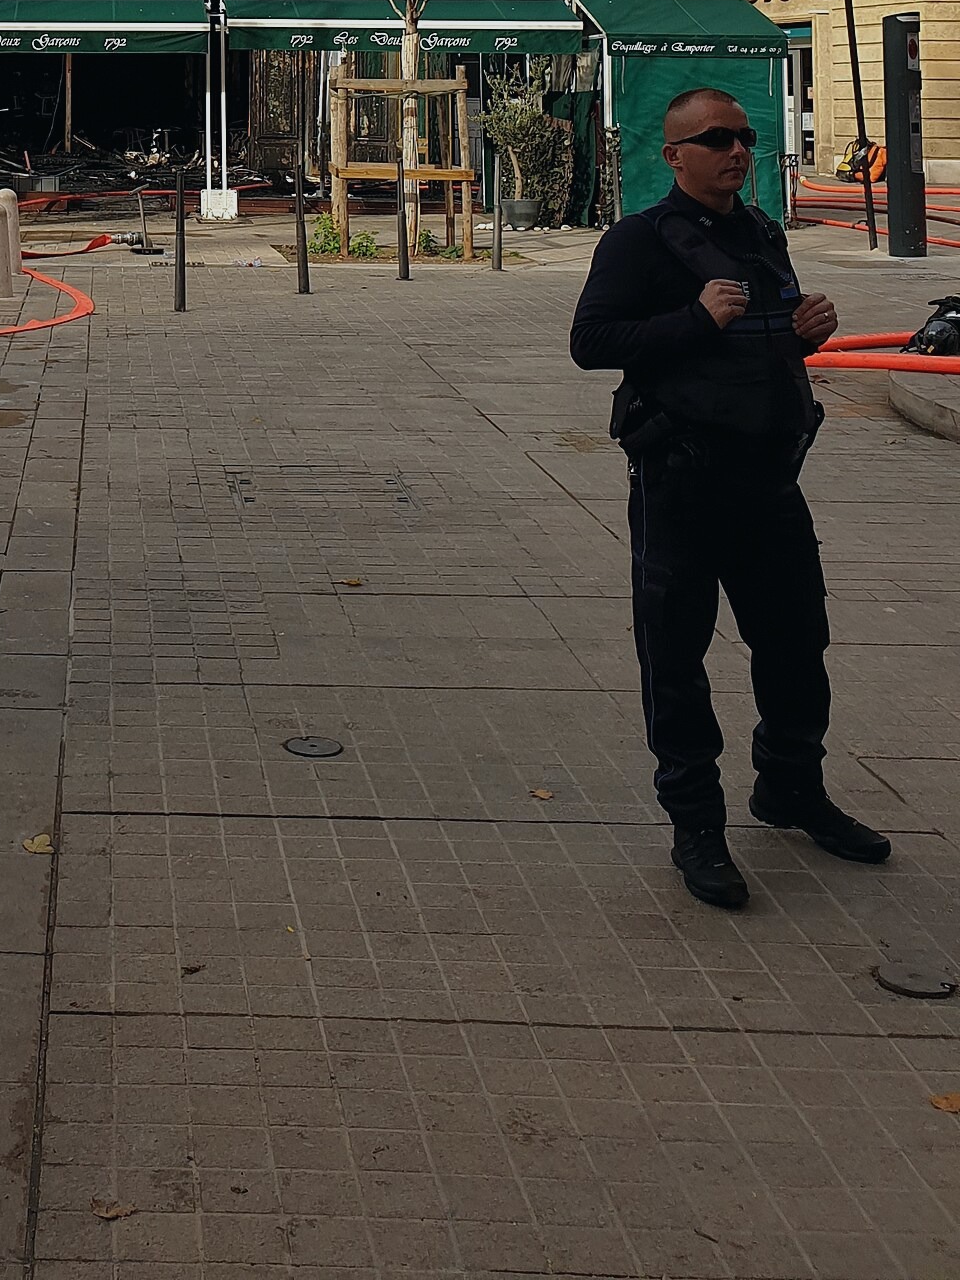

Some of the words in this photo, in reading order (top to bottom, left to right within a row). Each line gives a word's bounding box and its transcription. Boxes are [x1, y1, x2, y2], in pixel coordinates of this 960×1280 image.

[31, 33, 81, 50] Garçons
[104, 37, 127, 50] 1792
[290, 34, 313, 47] 1792
[419, 32, 472, 51] Garçons
[494, 36, 518, 50] 1792
[611, 40, 657, 54] Coquillages
[671, 42, 716, 54] Emporter
[699, 216, 713, 227] PM
